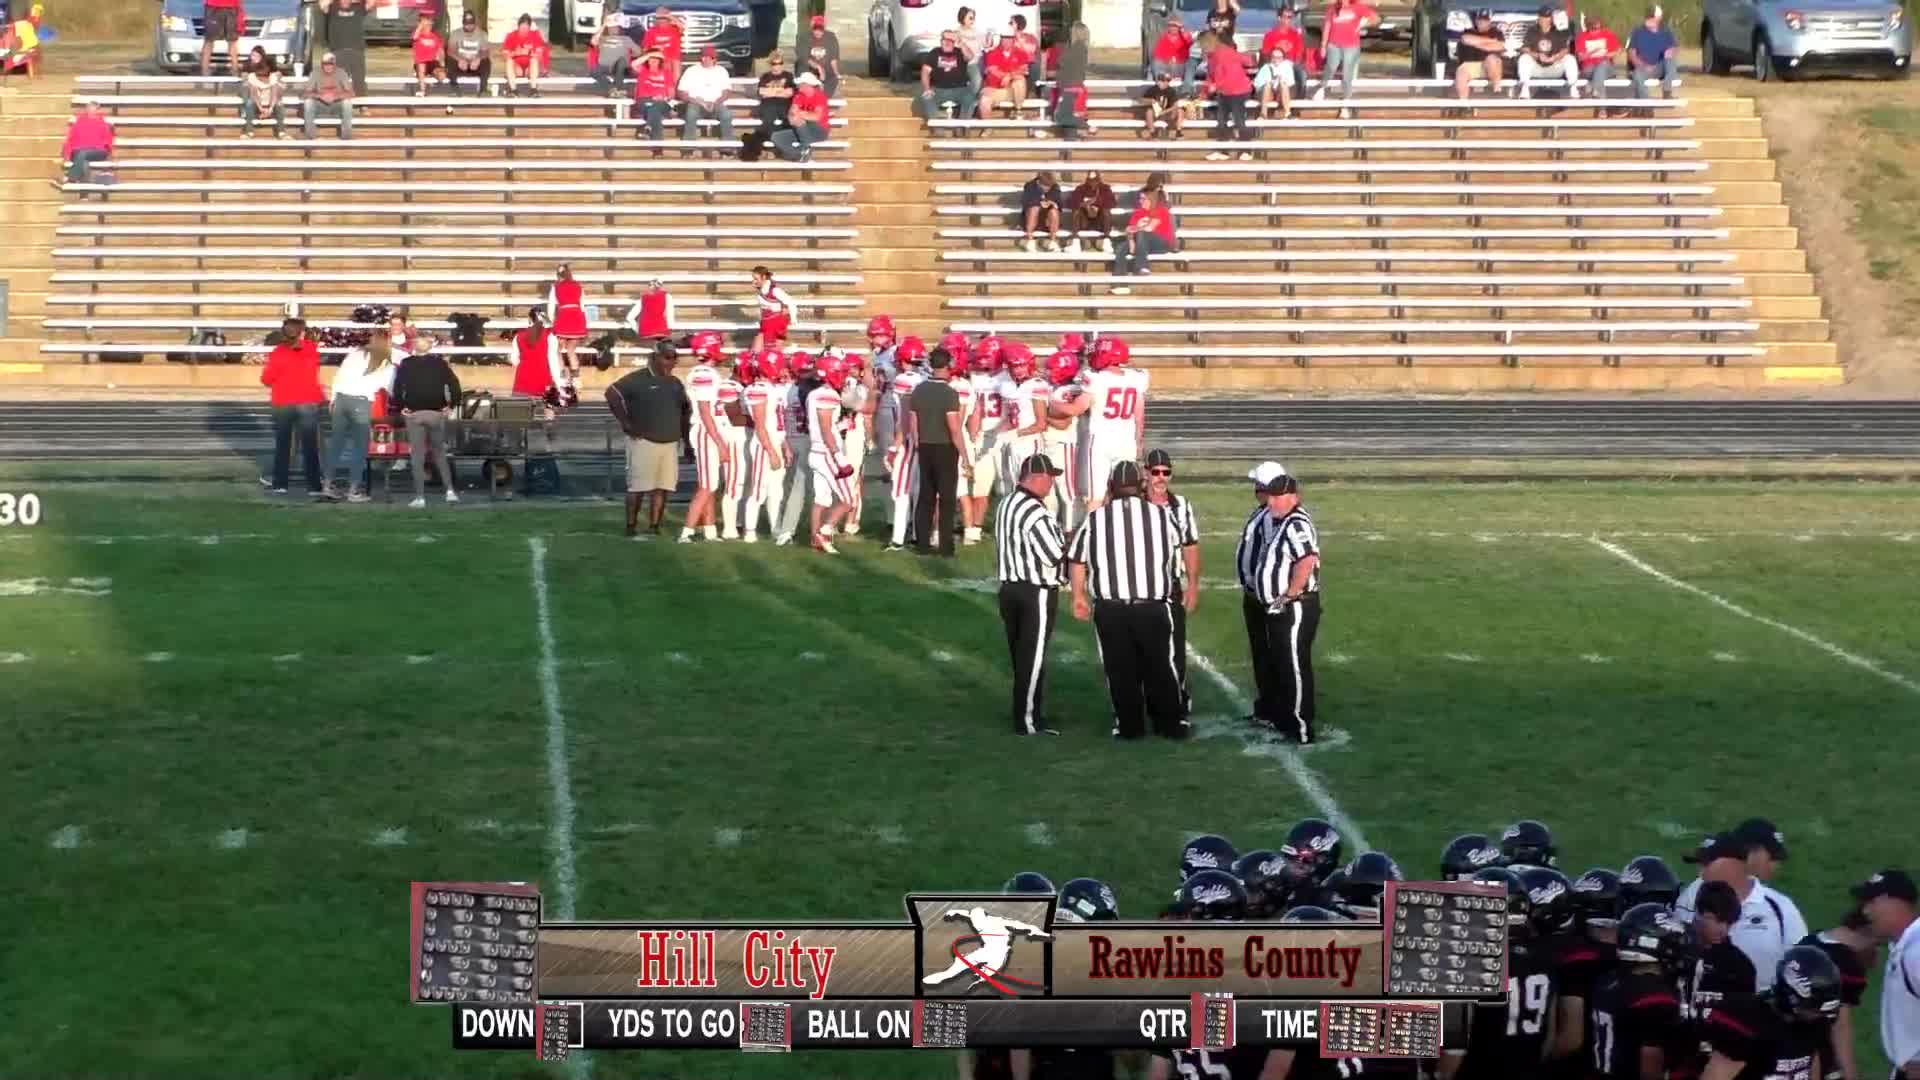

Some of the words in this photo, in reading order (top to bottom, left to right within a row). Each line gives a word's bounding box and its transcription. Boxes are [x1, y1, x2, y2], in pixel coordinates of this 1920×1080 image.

[1103, 386, 1138, 420] 50
[0, 492, 41, 526] 30
[1507, 974, 1550, 1036] 19
